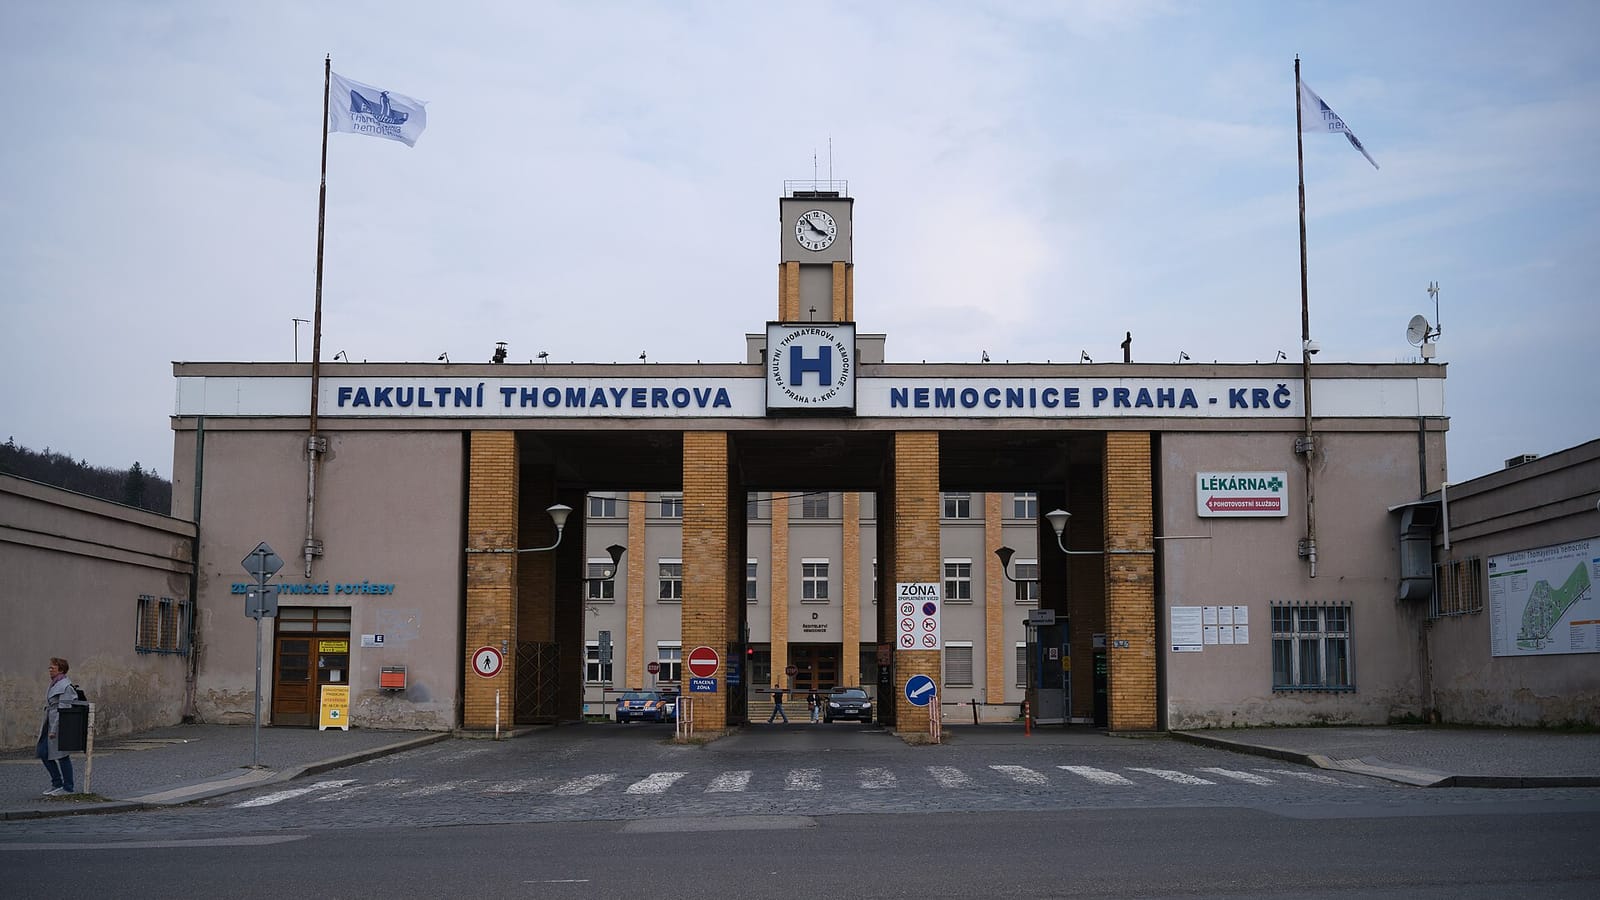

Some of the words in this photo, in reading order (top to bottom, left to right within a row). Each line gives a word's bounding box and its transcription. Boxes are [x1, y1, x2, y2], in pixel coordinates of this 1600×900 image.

[780, 328, 835, 347] THOMAYEROVA
[835, 342, 850, 387] NEMOCNICE
[790, 345, 832, 386] H
[338, 382, 485, 408] FAKULTNÍ
[500, 387, 732, 408] THOMAYEROVA
[784, 388, 809, 404] PRAHA
[890, 387, 1081, 409] NEMOCNICE
[1092, 387, 1199, 409] PRAHA
[1229, 383, 1291, 409] KRČ
[1201, 475, 1267, 491] LÉKÁRNA
[231, 580, 330, 596] ZDTNICKÉ
[335, 580, 395, 596] POTŘEBY
[901, 583, 936, 596] ZÓNA
[812, 612, 819, 620] D
[903, 605, 912, 613] 20
